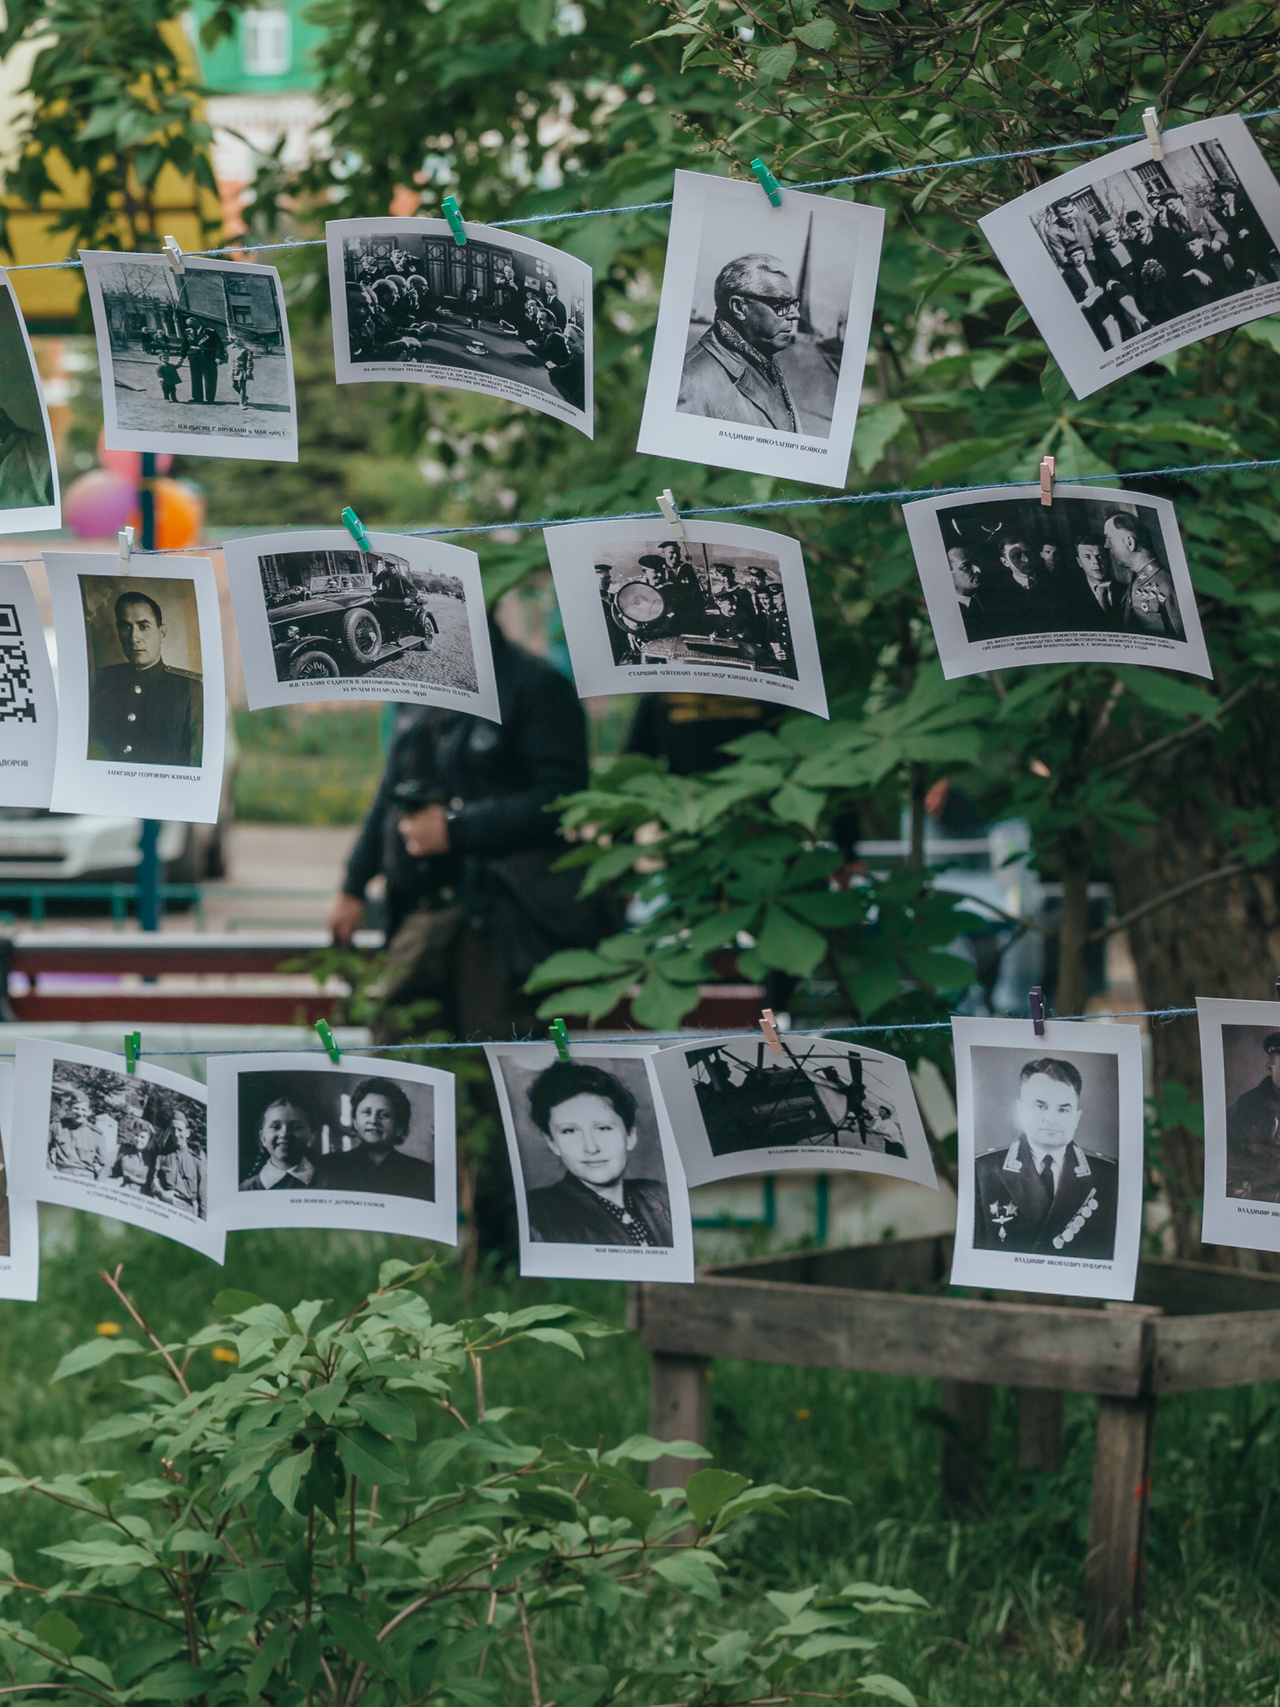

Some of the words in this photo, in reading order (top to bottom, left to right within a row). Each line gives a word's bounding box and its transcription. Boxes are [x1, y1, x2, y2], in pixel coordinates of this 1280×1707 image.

[719, 430, 754, 441] ВЛАДИМИР
[756, 437, 799, 450] НИКОЛАЕВИЧ
[800, 445, 828, 455] БОЙКОВ
[420, 683, 451, 693] БОЛЬШОГО
[766, 680, 794, 690] ЭКИПАЖЕМ
[1238, 1207, 1270, 1215] ВЛАДИМИР
[1047, 1260, 1080, 1268] ЯКОВЛЕВИЧ
